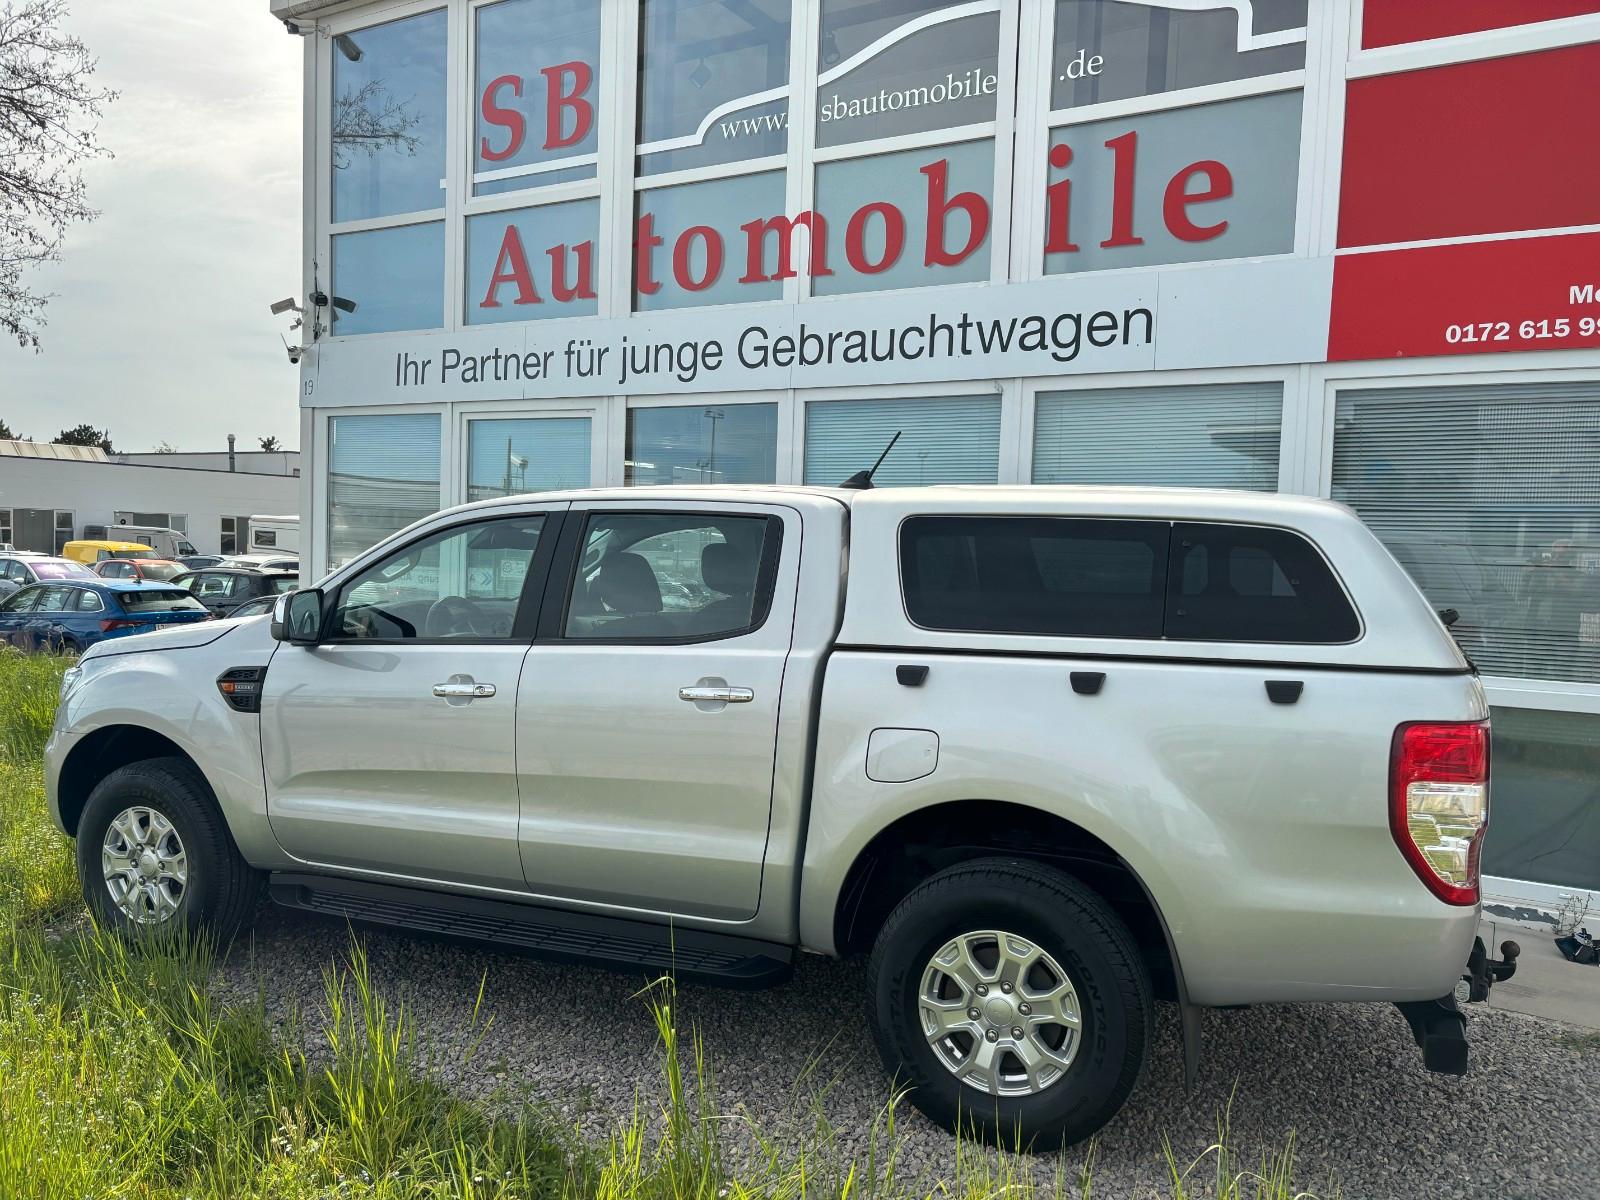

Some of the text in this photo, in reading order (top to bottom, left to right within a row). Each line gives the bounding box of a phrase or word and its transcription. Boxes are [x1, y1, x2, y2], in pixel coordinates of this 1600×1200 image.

[480, 60, 594, 162] SB
[395, 306, 1154, 387] Ihr Partner für junge Gebrauchtwagen
[1445, 316, 1600, 343] 0172 615 9
